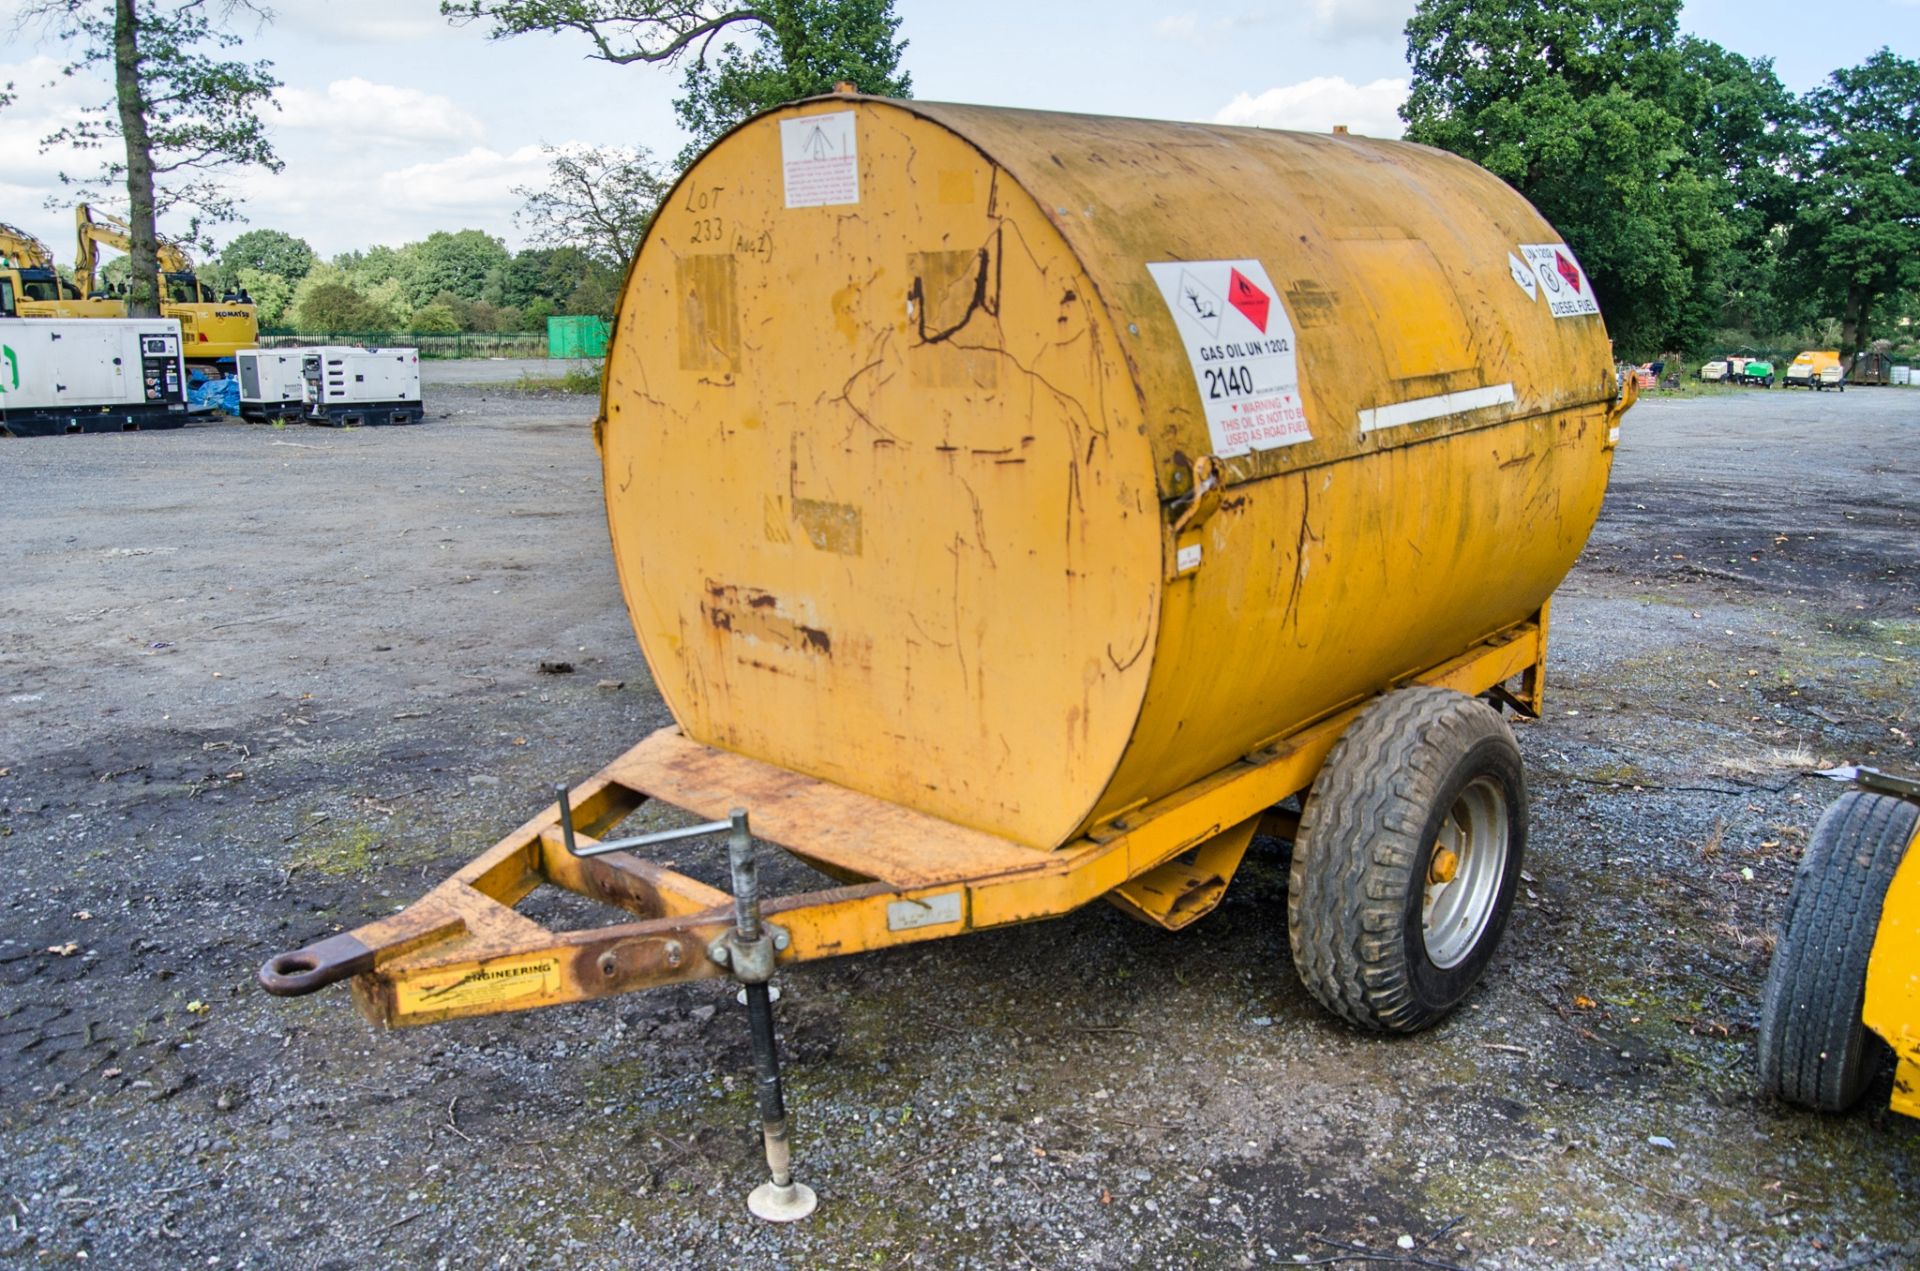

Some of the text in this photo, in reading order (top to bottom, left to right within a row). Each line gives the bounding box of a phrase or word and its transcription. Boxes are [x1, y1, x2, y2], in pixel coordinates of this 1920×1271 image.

[685, 181, 725, 213] LOT
[690, 217, 723, 244] 233
[1552, 299, 1597, 315] DIESEL FUEL
[1200, 338, 1290, 361] GAS OIL UN 1202
[1204, 365, 1253, 399] 2140
[1241, 397, 1282, 414] WARNING
[1221, 419, 1241, 432] THIS
[1241, 417, 1254, 429] OIL
[1255, 414, 1266, 427] IS
[1266, 410, 1284, 425] NOT
[1282, 407, 1295, 421] TO
[1225, 431, 1249, 446] USED
[1250, 427, 1263, 441] AS
[1263, 423, 1287, 438] ROAD
